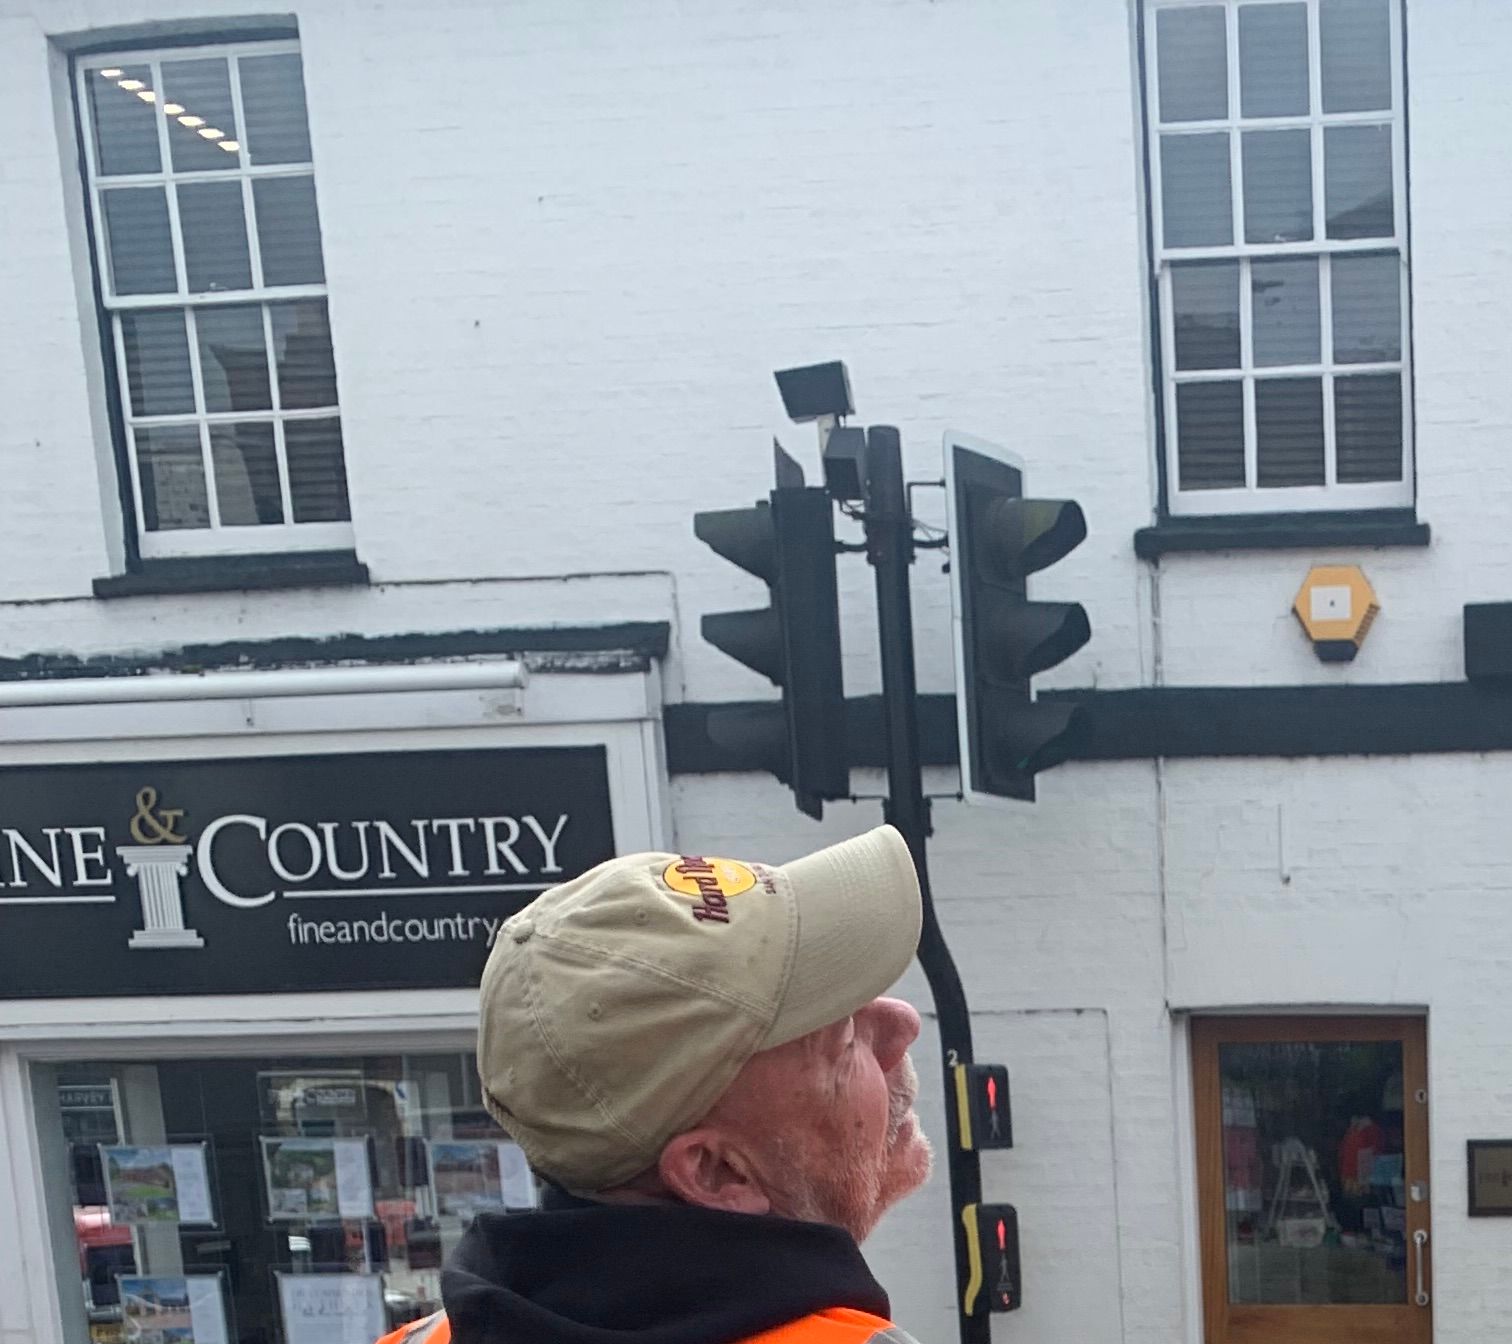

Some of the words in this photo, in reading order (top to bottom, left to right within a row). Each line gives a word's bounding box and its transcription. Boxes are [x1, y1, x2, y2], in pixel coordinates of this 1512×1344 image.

[0, 827, 113, 888] NE
[129, 786, 189, 845] &
[197, 813, 569, 908] COUNTRY
[288, 909, 499, 949] fineandcountry
